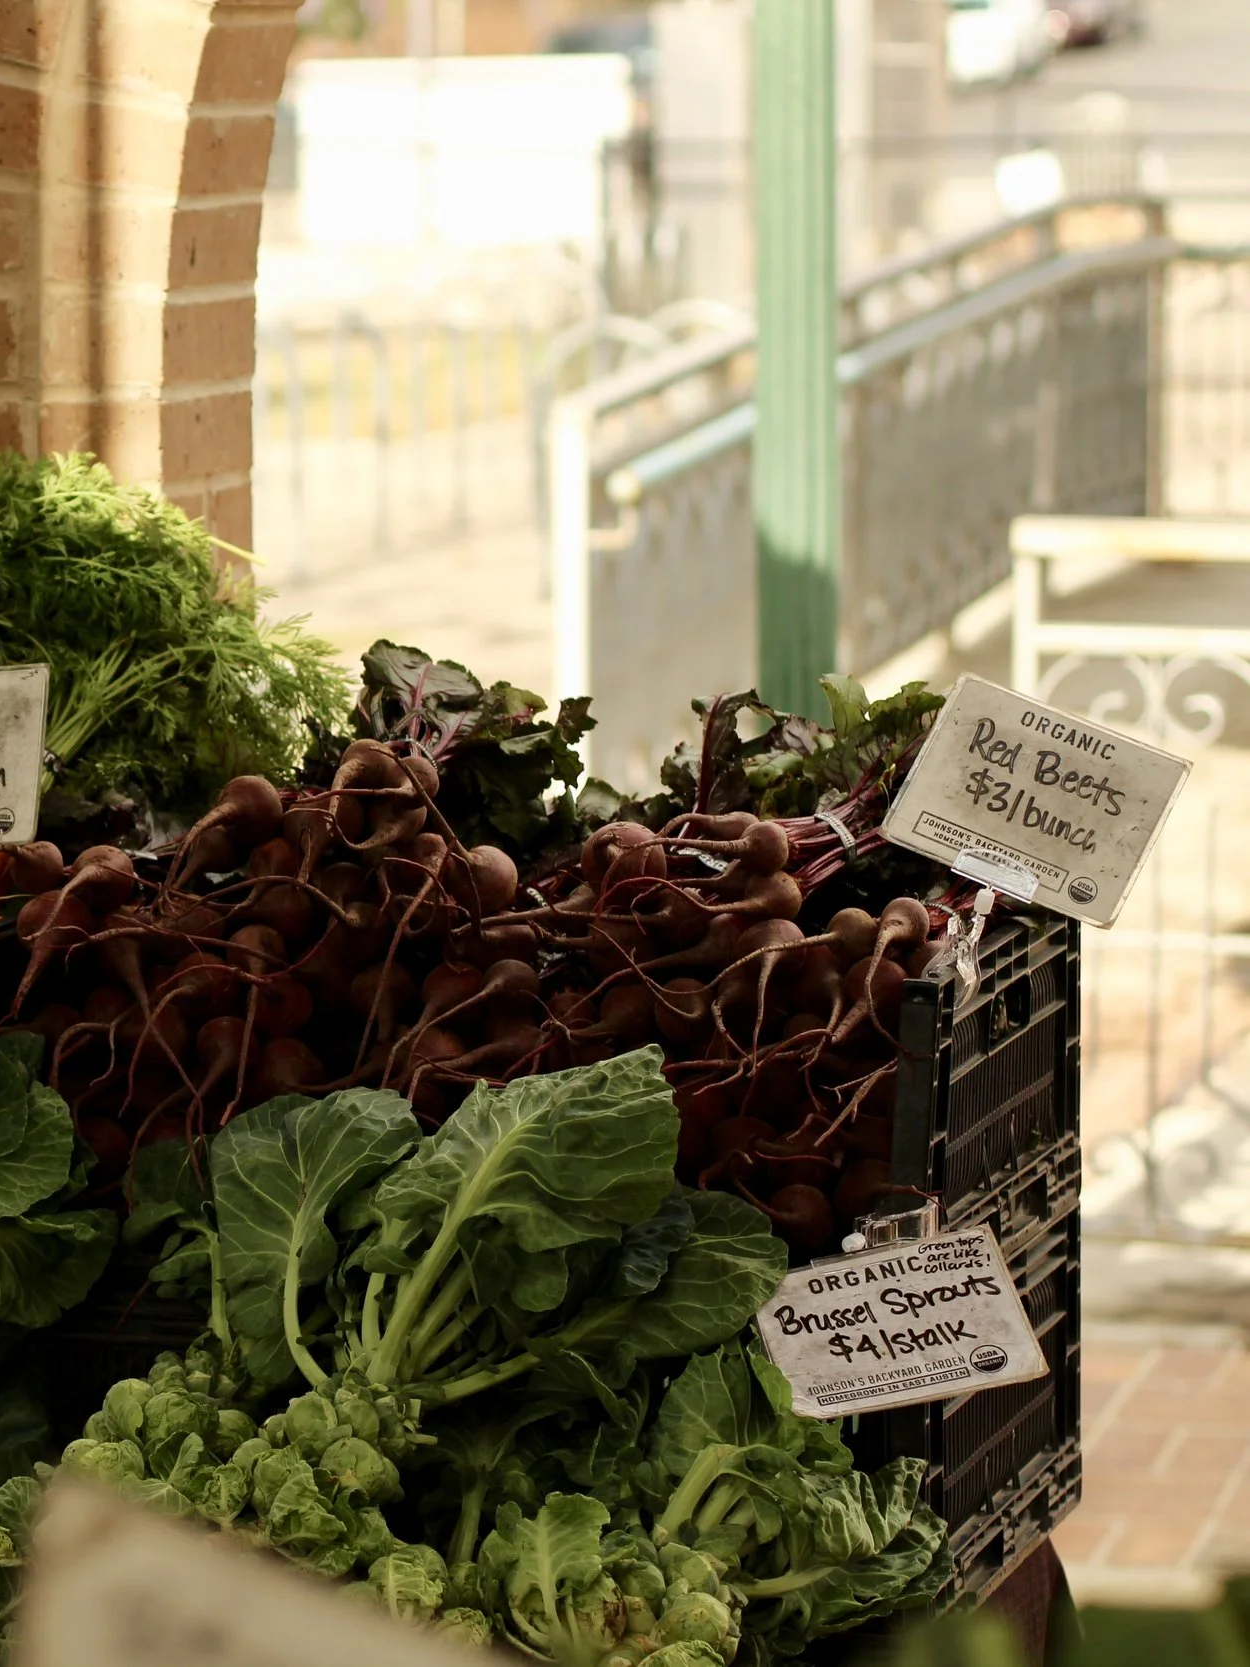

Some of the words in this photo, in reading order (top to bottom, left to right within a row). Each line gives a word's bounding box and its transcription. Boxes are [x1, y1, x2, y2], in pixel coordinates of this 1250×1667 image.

[1020, 711, 1115, 760] ORGANIC
[968, 717, 1023, 774] Red
[1033, 750, 1126, 815] Beets
[965, 768, 1097, 853] $3/bunch
[922, 818, 972, 842] JOHNSON'S
[975, 838, 1021, 861] BACKYARD
[1024, 858, 1060, 879] GARDEN
[1077, 881, 1093, 892] USDA
[918, 1241, 955, 1254] Green
[956, 1235, 984, 1248] tops
[927, 1252, 950, 1263] are
[807, 1255, 923, 1295] ORGANIC
[773, 1301, 879, 1336] Brussel
[880, 1274, 1001, 1318] Sprouts
[977, 1349, 999, 1360] USDA
[977, 1357, 1004, 1367] ORGANIC
[807, 1377, 865, 1396] JOHNSON'S
[868, 1365, 922, 1384] BACKYARD
[926, 1355, 966, 1373] GARDEN
[821, 1387, 885, 1405] HOMEGROWN
[902, 1378, 926, 1388] EAST
[930, 1369, 967, 1383] AUSTIN
